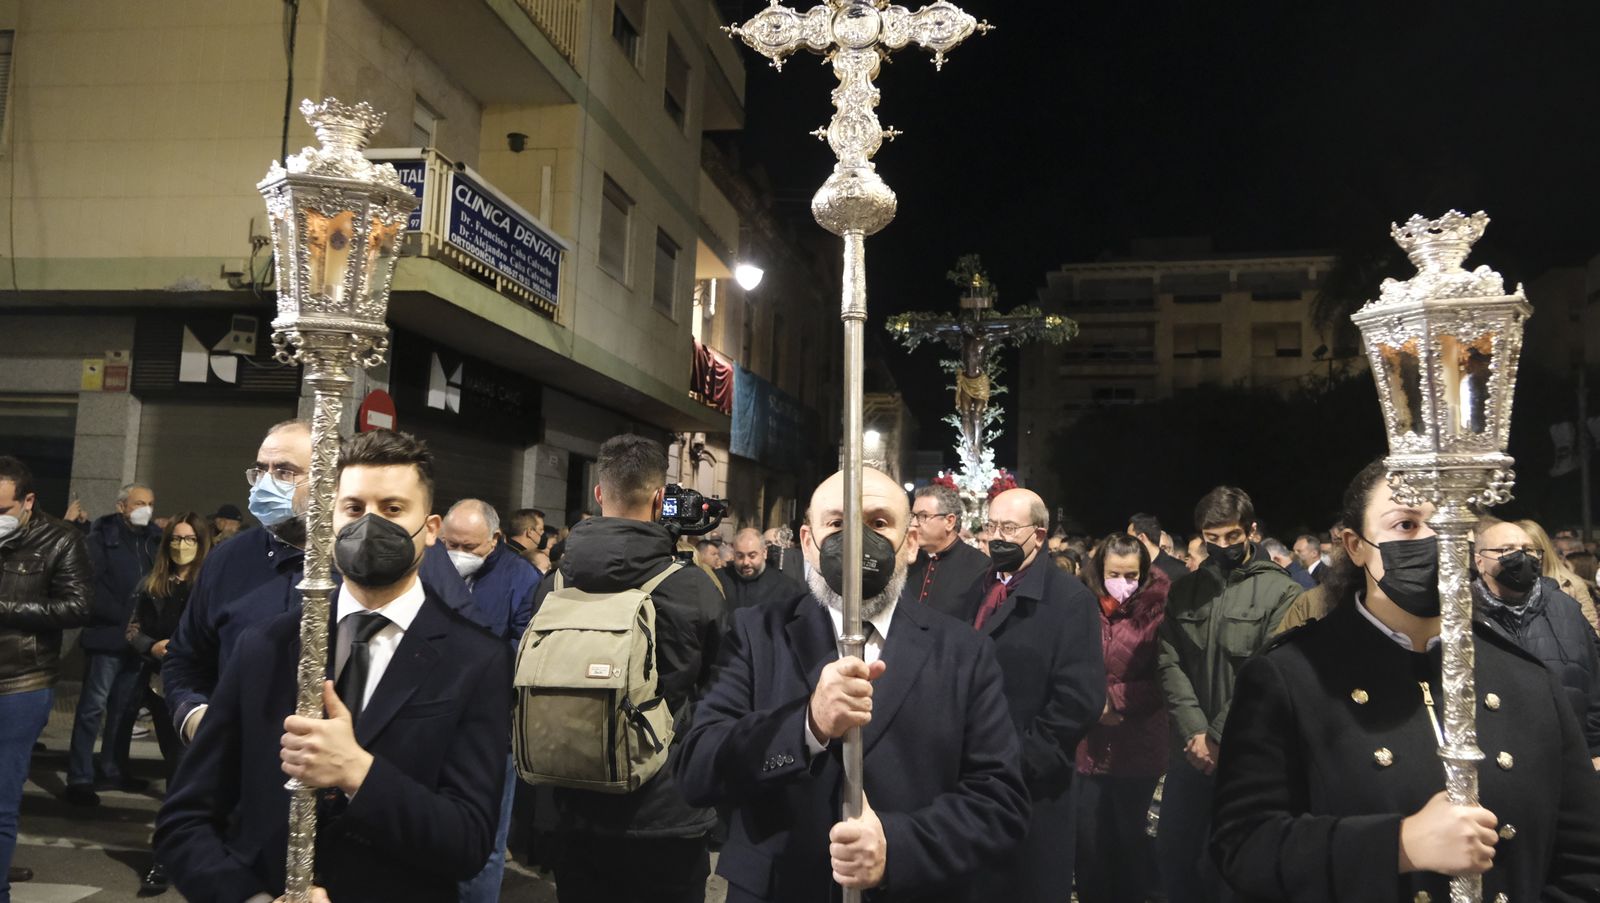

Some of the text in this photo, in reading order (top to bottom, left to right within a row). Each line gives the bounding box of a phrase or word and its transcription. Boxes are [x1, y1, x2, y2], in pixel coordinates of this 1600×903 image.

[410, 219, 420, 228] 97
[455, 184, 557, 265] CLINICA DENTAL
[460, 211, 474, 227] Dr.
[475, 221, 508, 249] Francisco
[451, 232, 496, 266] ORTODONCIA
[474, 234, 507, 262] Alejandro
